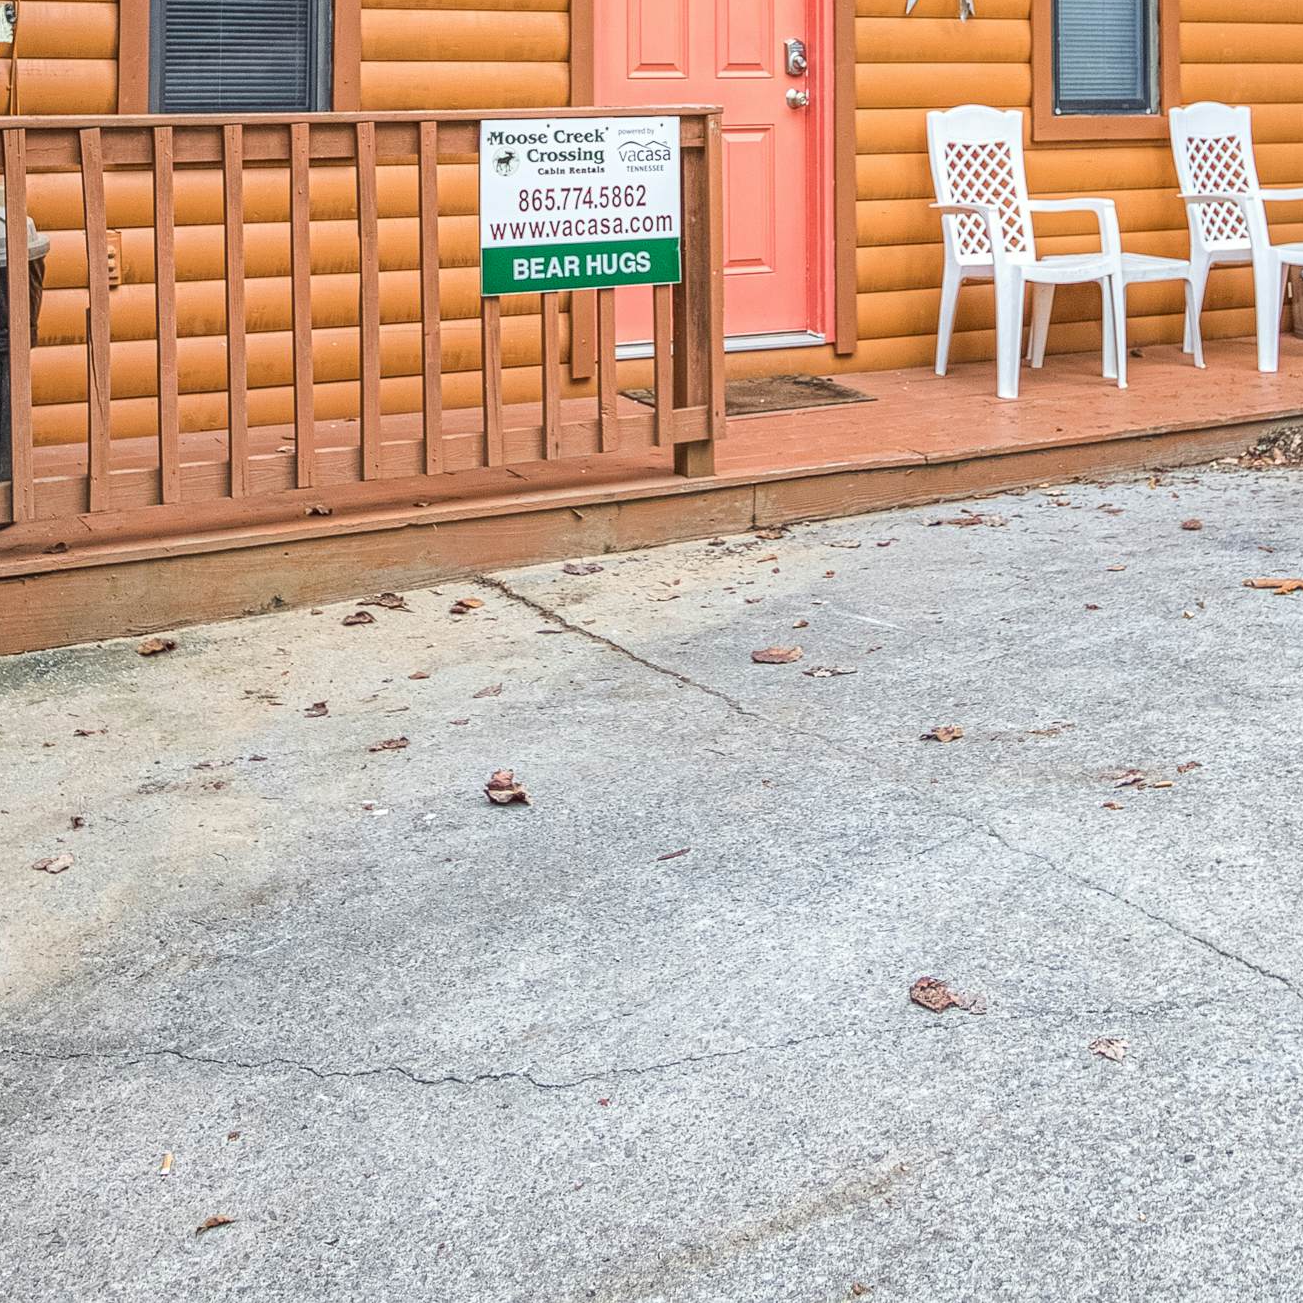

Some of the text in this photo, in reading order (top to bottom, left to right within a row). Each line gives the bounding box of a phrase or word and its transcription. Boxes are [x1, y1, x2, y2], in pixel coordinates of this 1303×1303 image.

[487, 129, 605, 146] Moose Creek
[618, 127, 655, 136] powered by
[526, 147, 605, 165] Crossing
[618, 149, 672, 163] vacasa
[537, 165, 606, 176] Cabin Rentals
[626, 164, 665, 173] TENNESSEE
[518, 184, 647, 213] 865.774.5862
[490, 213, 674, 241] www.vacasa.com
[513, 251, 652, 281] BEAR HUGS
